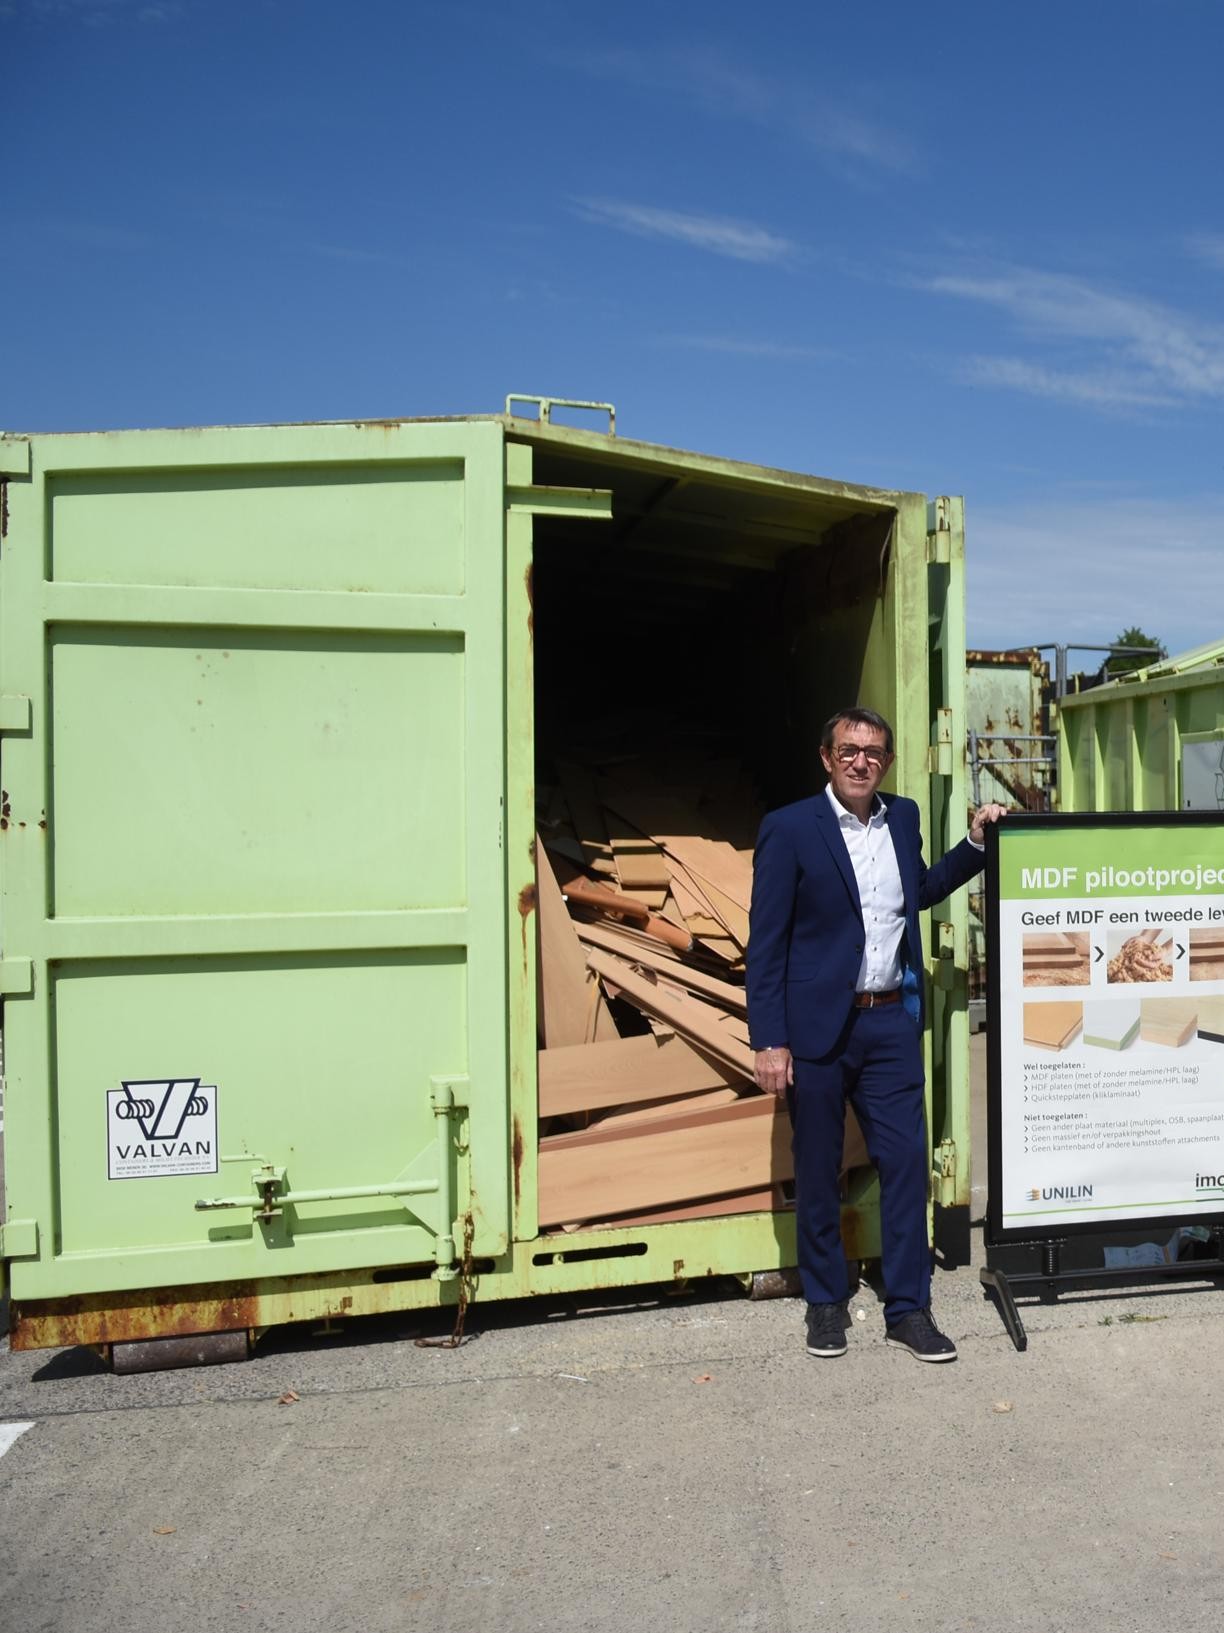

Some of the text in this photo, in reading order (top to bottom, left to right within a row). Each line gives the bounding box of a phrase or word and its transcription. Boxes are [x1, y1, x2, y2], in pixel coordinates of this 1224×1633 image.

[1021, 867, 1078, 889] MDF
[1021, 911, 1061, 926] Geef
[1066, 910, 1105, 924] MDF
[1109, 911, 1139, 923] een
[1144, 908, 1203, 922] tweede
[1023, 1063, 1038, 1071] Wel
[1040, 1062, 1081, 1071] toegelaten
[1031, 1065, 1200, 1081] MDF platen (met of zonder melamine/HPL laag)
[1031, 1076, 1199, 1091] HDF platen (met of zonder melamine/HPL laag)
[1031, 1089, 1141, 1103] Quickstepplaten (kliklaminaat)
[1042, 1112, 1084, 1122] toegelaten
[1052, 1123, 1073, 1131] ander
[1075, 1121, 1093, 1131] plaat
[1094, 1120, 1128, 1129] materiaal
[1052, 1133, 1080, 1141] massief
[1082, 1132, 1101, 1141] en/of
[1102, 1128, 1161, 1139] verpakkingshout
[116, 1141, 211, 1160] VALVAN
[1031, 1135, 1220, 1153] Geen kantenband of andere kunststoffen attachments
[1042, 1184, 1093, 1201] UNILIN
